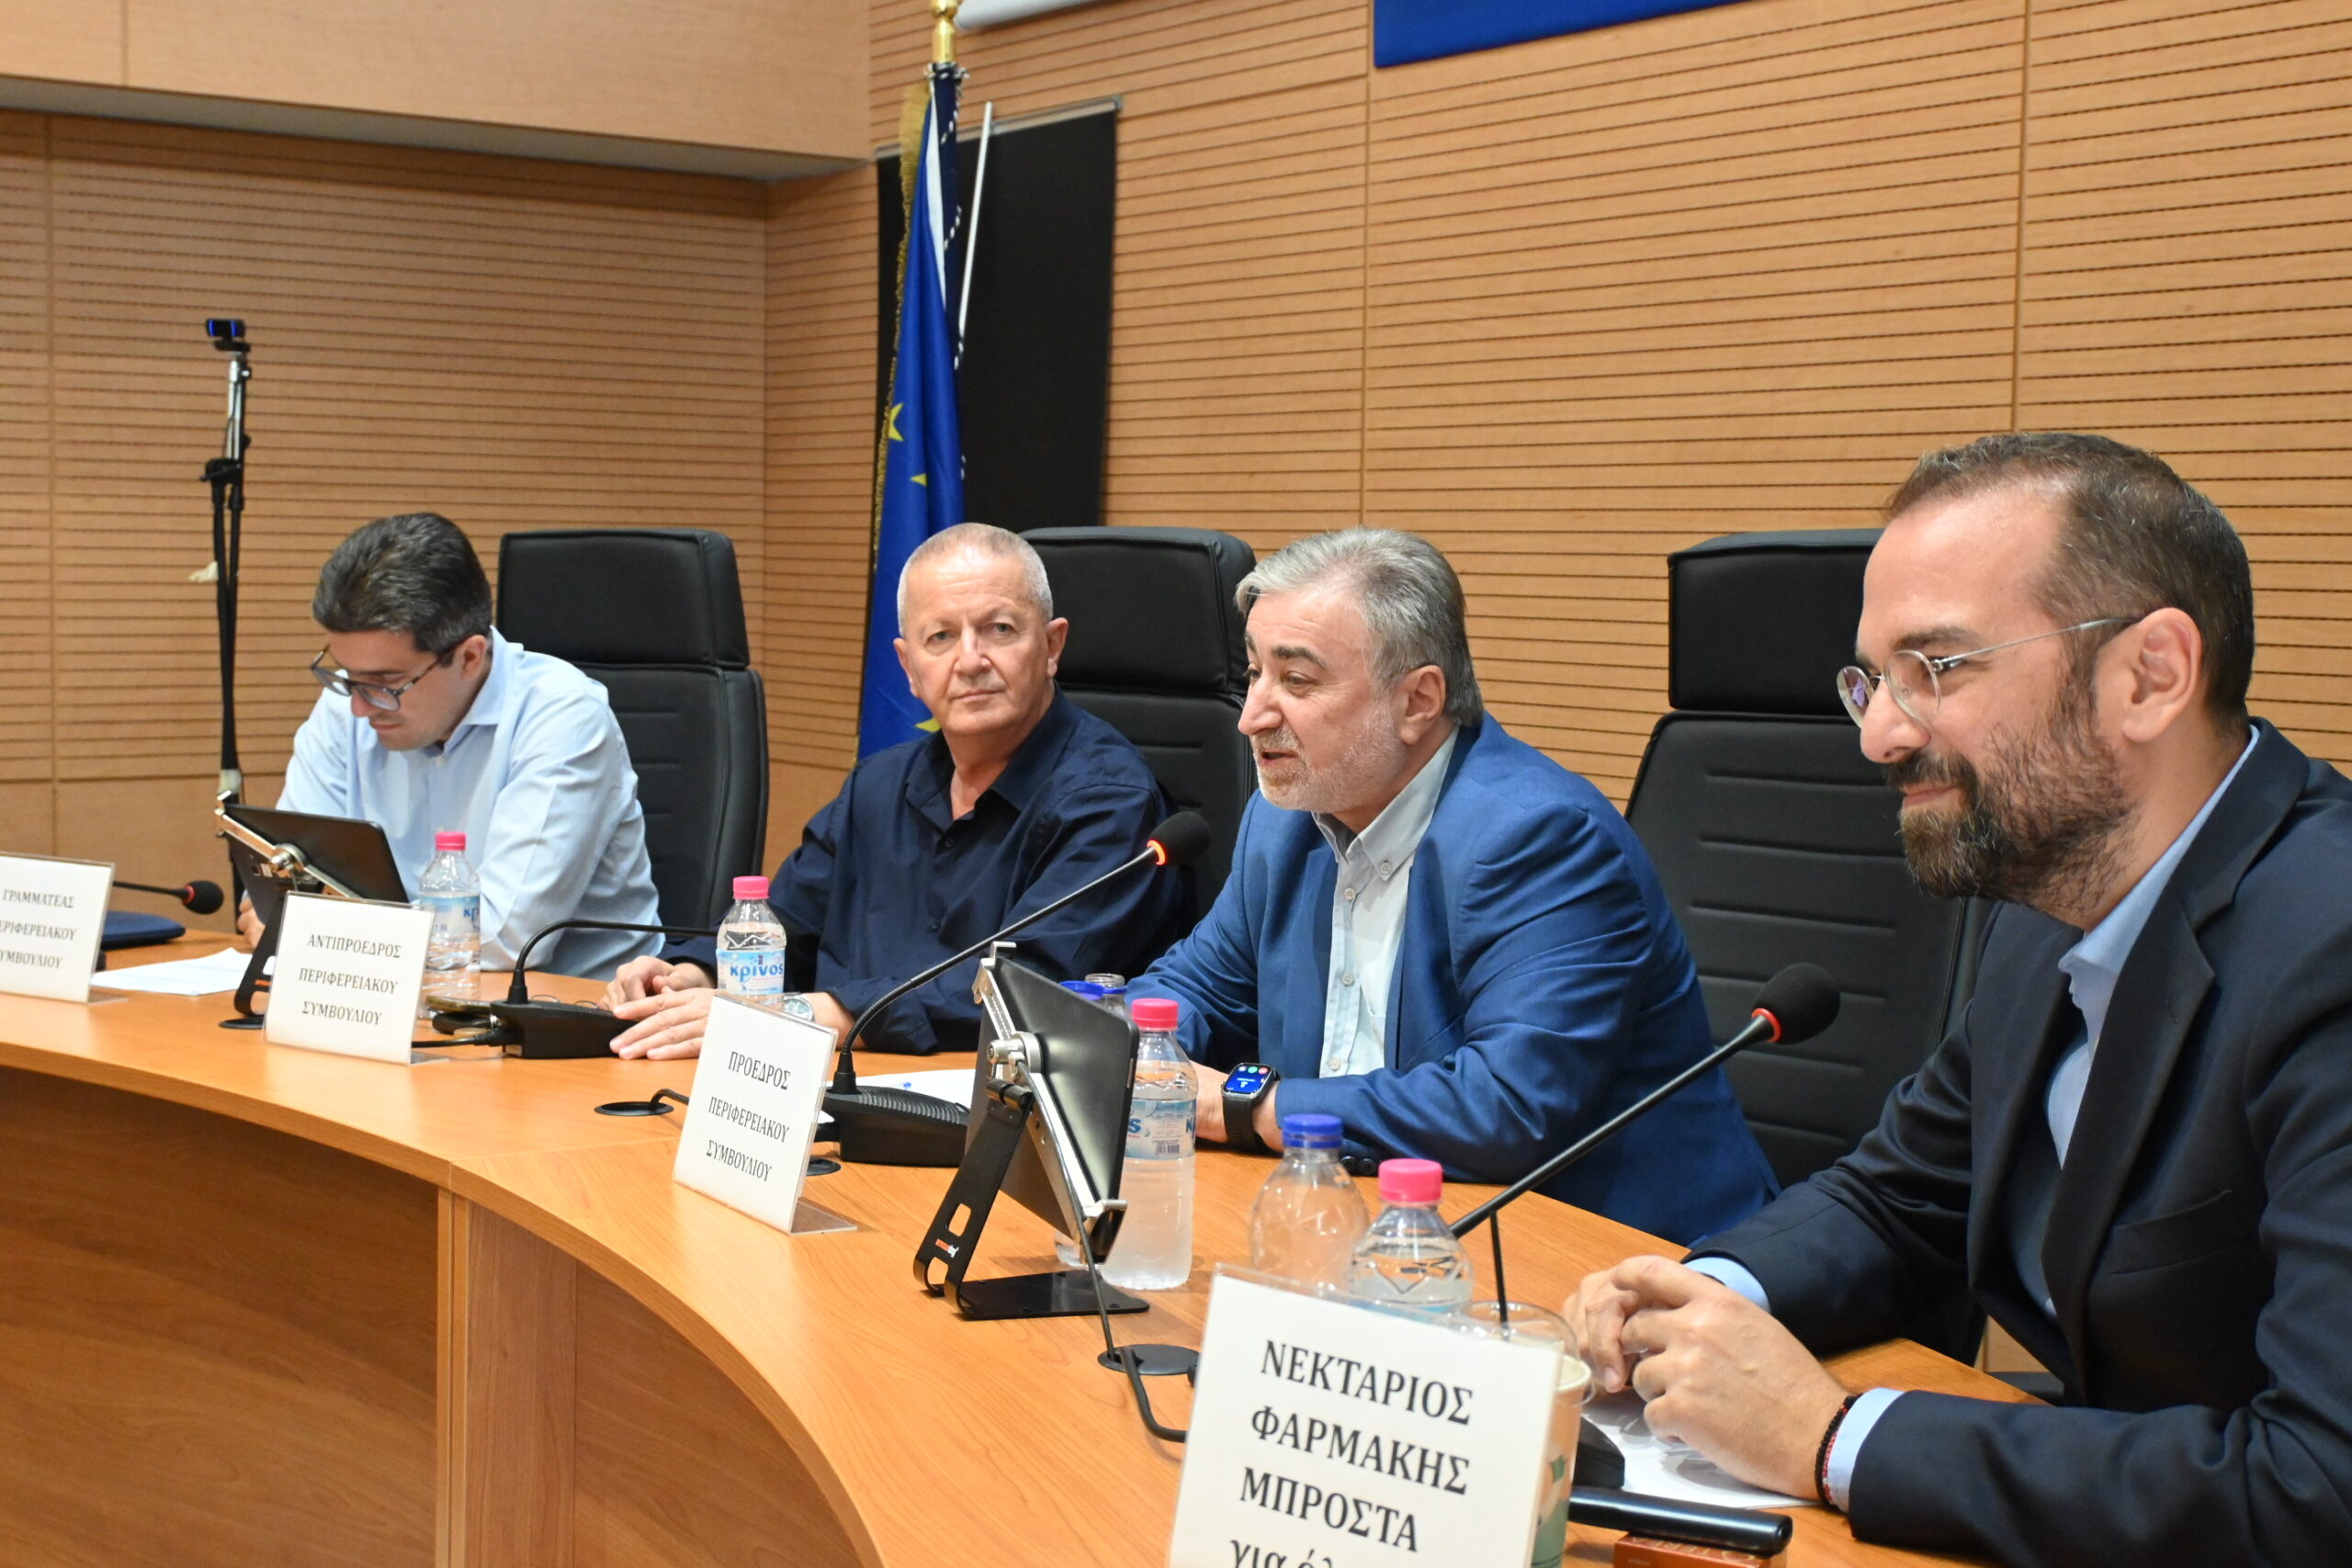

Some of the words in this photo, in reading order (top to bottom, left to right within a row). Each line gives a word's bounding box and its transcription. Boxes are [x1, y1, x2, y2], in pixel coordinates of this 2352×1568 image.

[3, 888, 74, 908] ΓΡΑΜΜΑΤΕΑΣ
[0, 920, 77, 941] ΕΡΙΦΕΡΕΙΑΚΟΥ
[307, 933, 401, 958] ΑΝΤΙΠΡΟΕΔΡΟΣ
[0, 949, 62, 968] ΥΜΒΟΥΛΙΟΥ
[299, 967, 399, 994] ΠΕΡΙΦΕΡΕΙΑΚΟΥ
[301, 1000, 382, 1025] ΣΥΜΒΟΥΛΙΟΥ
[728, 1051, 791, 1090] ΠΡΟΕΔΡΟΣ
[708, 1096, 790, 1143] ΠΕΡΙΦΕΡΕΙΑΚΟΥ
[706, 1139, 773, 1182] ΣΥΜΒΟΥΛΙΟΥ
[1261, 1339, 1474, 1426] ΝΕΚΤΑΡΙΟΣ
[1250, 1405, 1470, 1496] ΦΑΡΜΑΚΗΣ
[1239, 1467, 1419, 1552] ΜΠΡΟΣΤΑ
